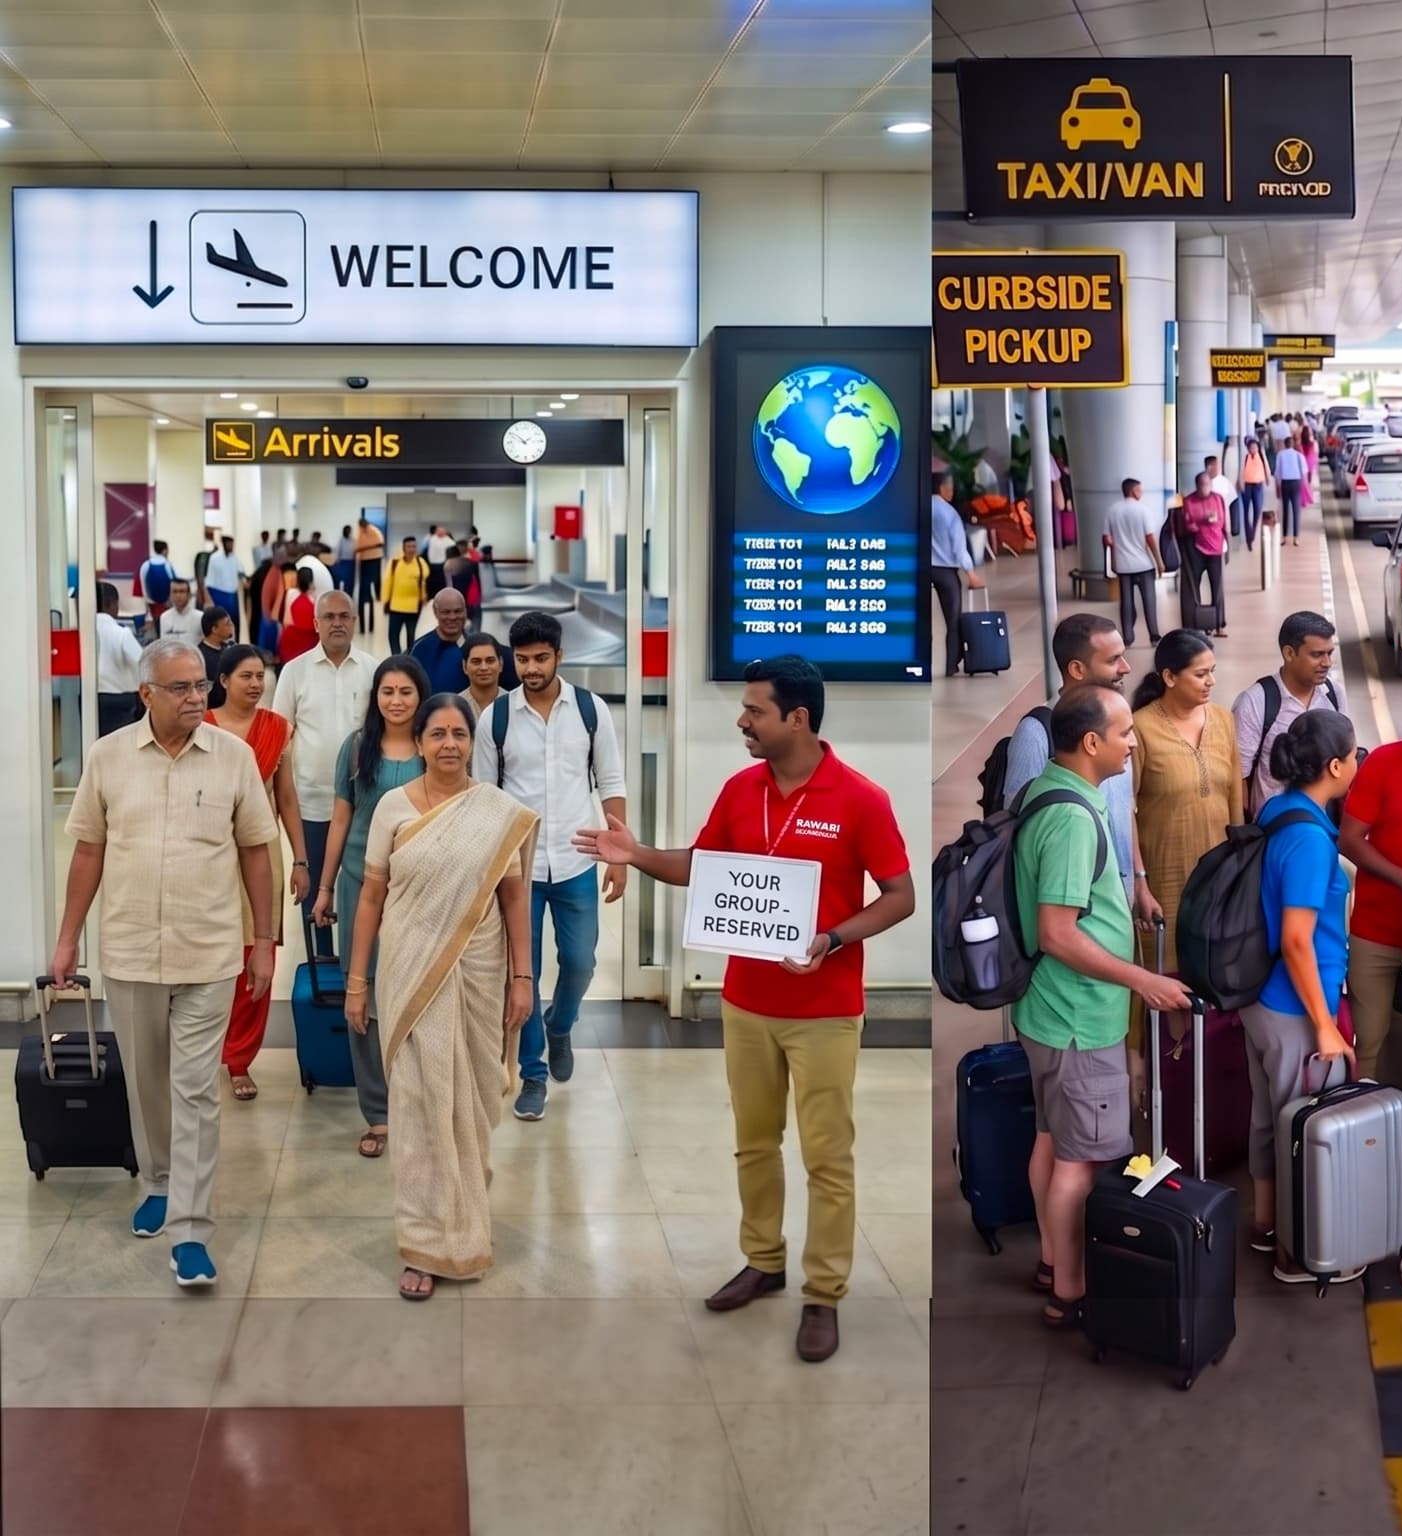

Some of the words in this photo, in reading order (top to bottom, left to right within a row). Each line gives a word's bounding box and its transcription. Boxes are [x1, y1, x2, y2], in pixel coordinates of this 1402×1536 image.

[997, 162, 1204, 200] TAXI/VAN
[331, 244, 614, 290] WELCOME
[938, 275, 1112, 311] CURBSIDE
[965, 328, 1092, 364] PICKUP
[263, 426, 400, 458] Arrivals
[729, 871, 781, 892] YOUR
[703, 915, 800, 942] RESERVED
